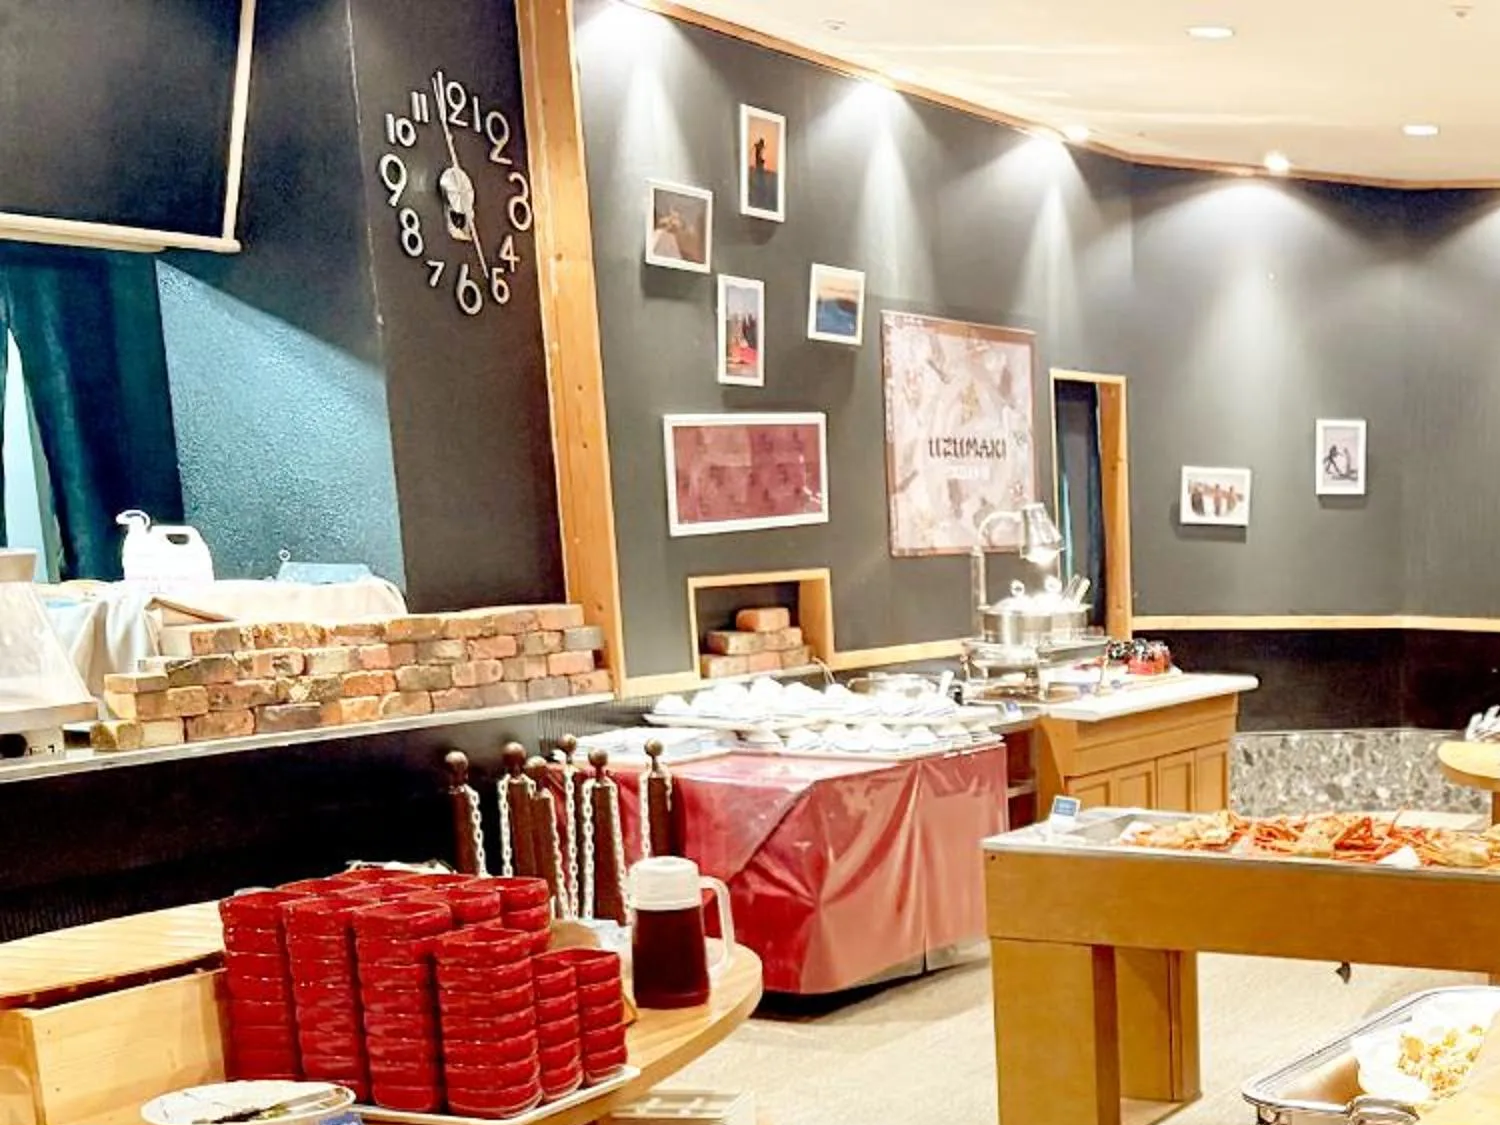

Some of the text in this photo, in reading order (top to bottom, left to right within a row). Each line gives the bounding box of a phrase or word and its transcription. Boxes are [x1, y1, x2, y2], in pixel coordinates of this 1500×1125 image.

[411, 91, 430, 123] 11
[435, 71, 468, 127] 12
[473, 95, 481, 133] 1
[385, 113, 416, 147] 10
[485, 111, 513, 165] 2
[379, 153, 407, 207] 9
[507, 172, 532, 231] 3
[400, 207, 425, 257] 8
[499, 235, 520, 273] 4
[426, 260, 445, 288] 7
[456, 263, 483, 316] 6
[490, 267, 511, 305] 5
[928, 436, 1007, 460] UZUMAKI
